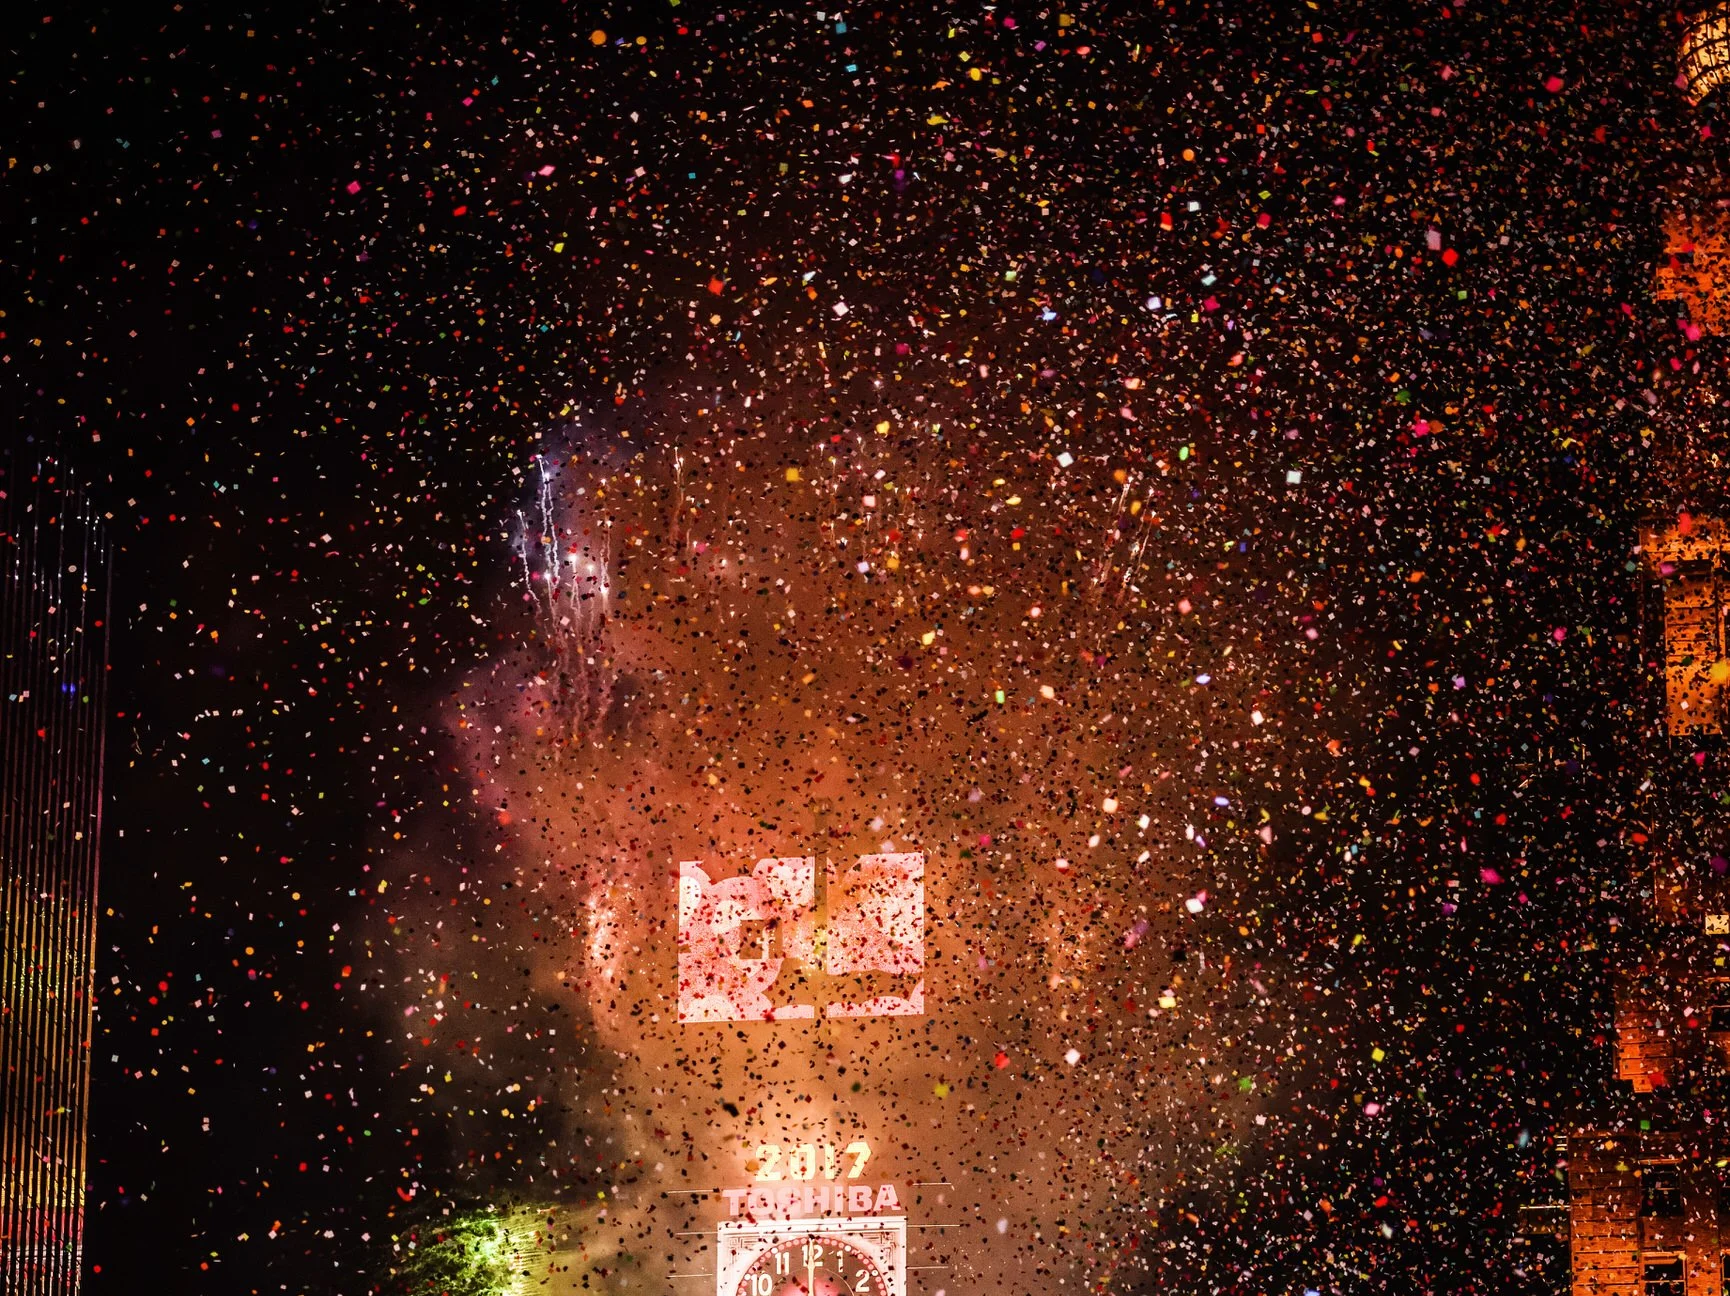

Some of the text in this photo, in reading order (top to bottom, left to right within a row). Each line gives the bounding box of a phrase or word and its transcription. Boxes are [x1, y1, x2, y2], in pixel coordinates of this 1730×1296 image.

[755, 1141, 872, 1182] 2017
[722, 1184, 902, 1218] TOSHIBA
[774, 1252, 790, 1275] 11
[801, 1244, 824, 1267] 12
[836, 1250, 844, 1273] 1
[751, 1273, 773, 1296] 10
[855, 1269, 870, 1293] 2
